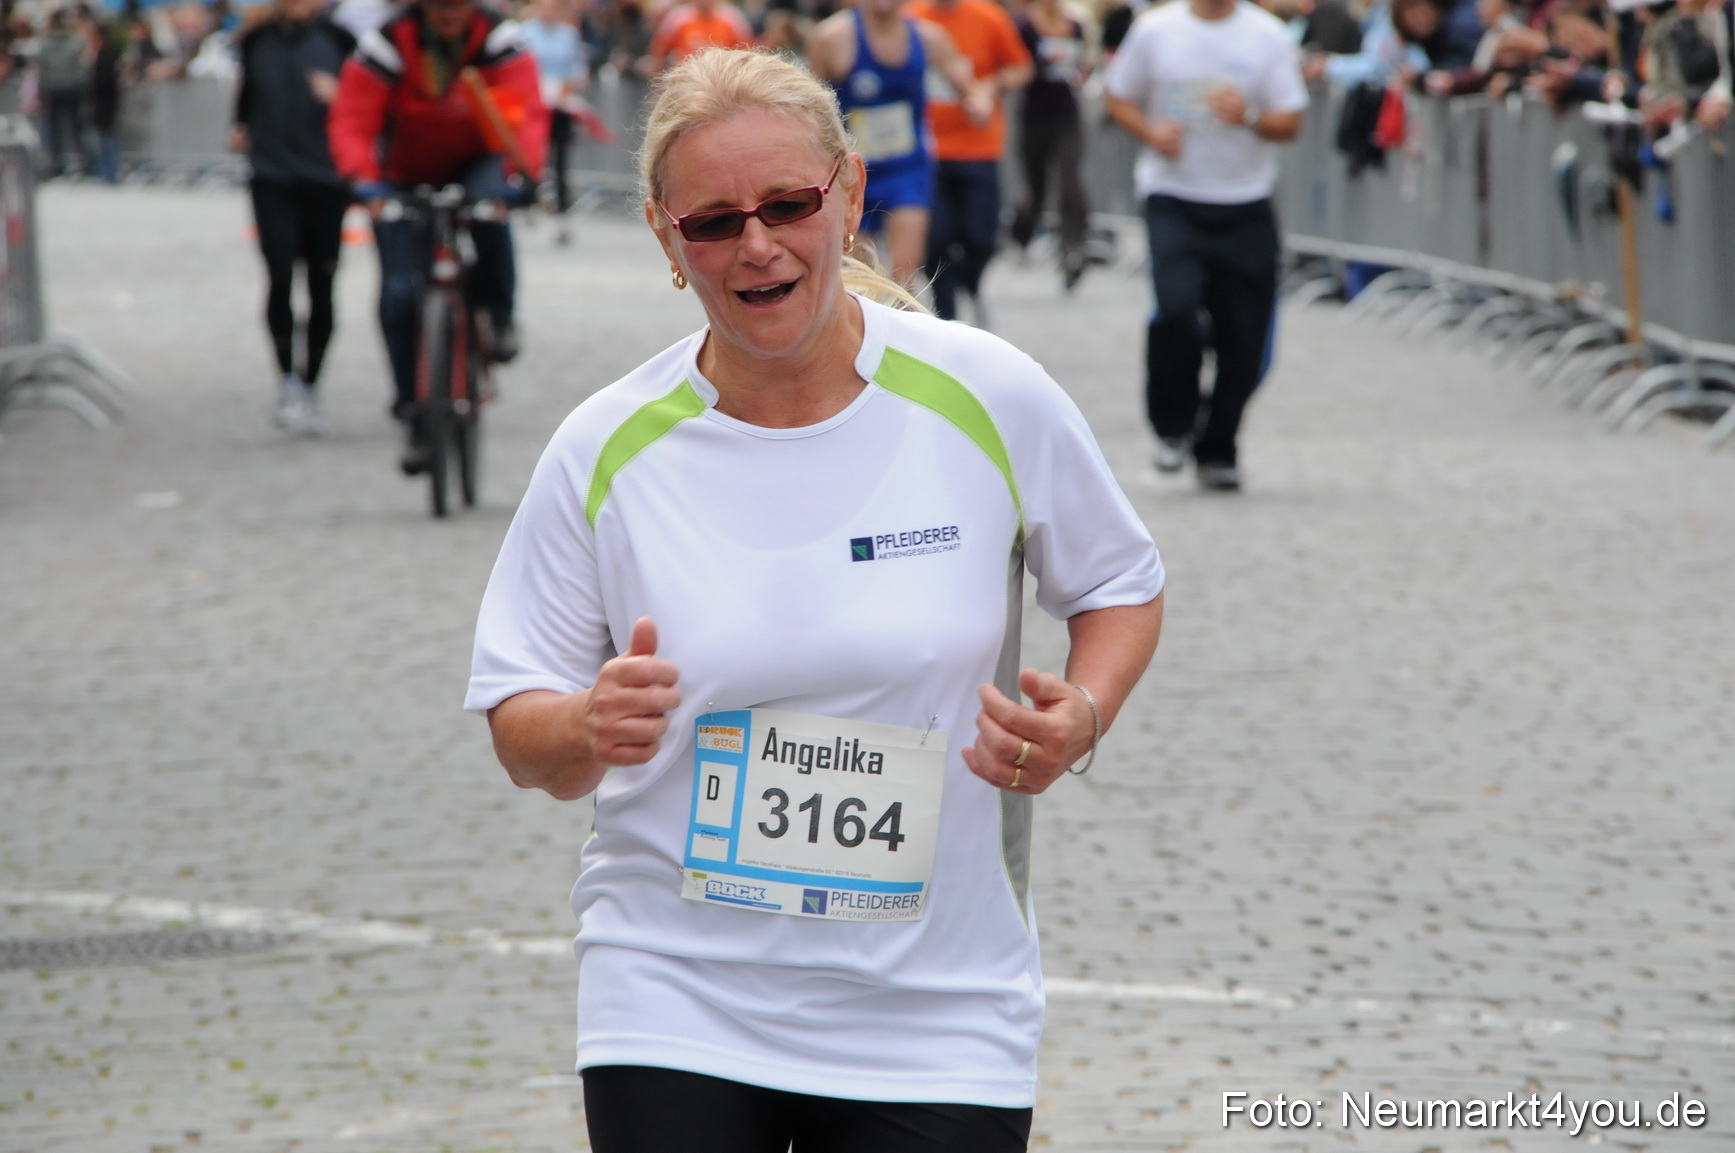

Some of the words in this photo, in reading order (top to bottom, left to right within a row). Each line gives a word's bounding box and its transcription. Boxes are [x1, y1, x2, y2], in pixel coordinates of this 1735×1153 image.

[875, 525, 960, 550] PFLEIDERER
[878, 543, 961, 560] AKTIENGESELLSCHAFT
[713, 737, 742, 750] BÜGL
[761, 727, 884, 775] Angelika
[706, 774, 720, 801] D
[757, 787, 905, 852] 3164
[705, 880, 766, 901] BOCK
[831, 891, 920, 910] PFLEIDERER
[829, 910, 919, 920] AKTIENGESELLSCHAFT
